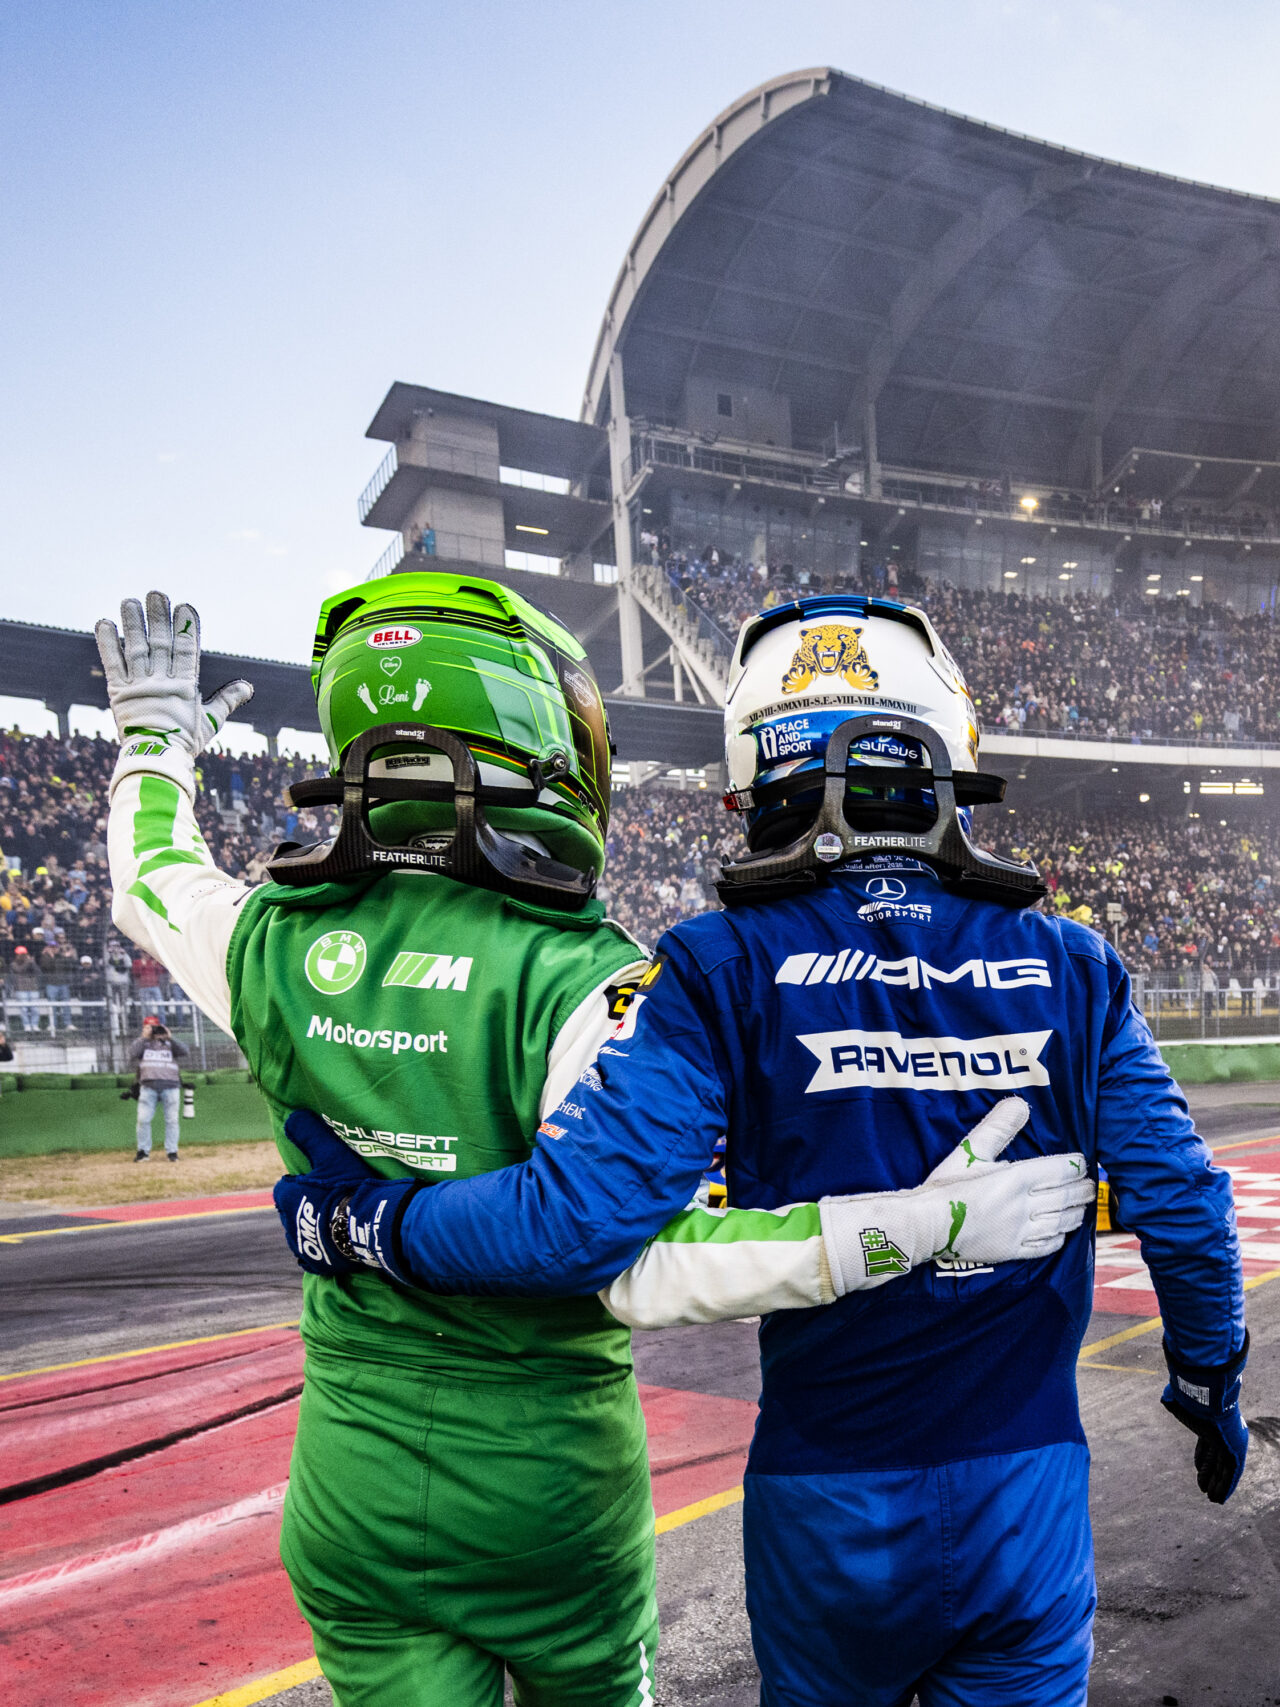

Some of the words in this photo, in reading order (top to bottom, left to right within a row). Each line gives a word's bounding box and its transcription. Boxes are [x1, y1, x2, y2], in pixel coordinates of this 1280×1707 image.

[373, 630, 413, 643] BELL
[379, 684, 409, 705] Leni
[776, 719, 810, 735] PEACE
[778, 732, 801, 746] AND
[779, 740, 812, 756] SPORT
[854, 836, 926, 847] FEATHERLITE
[373, 851, 446, 866] FEATHERLITE
[858, 910, 932, 922] MOTORSPORT
[320, 933, 364, 953] BMW
[306, 1015, 448, 1054] Motorsport
[830, 1044, 1030, 1078] RAVENOL
[321, 1113, 458, 1151] SCHUBERT
[300, 1201, 323, 1262] OMP
